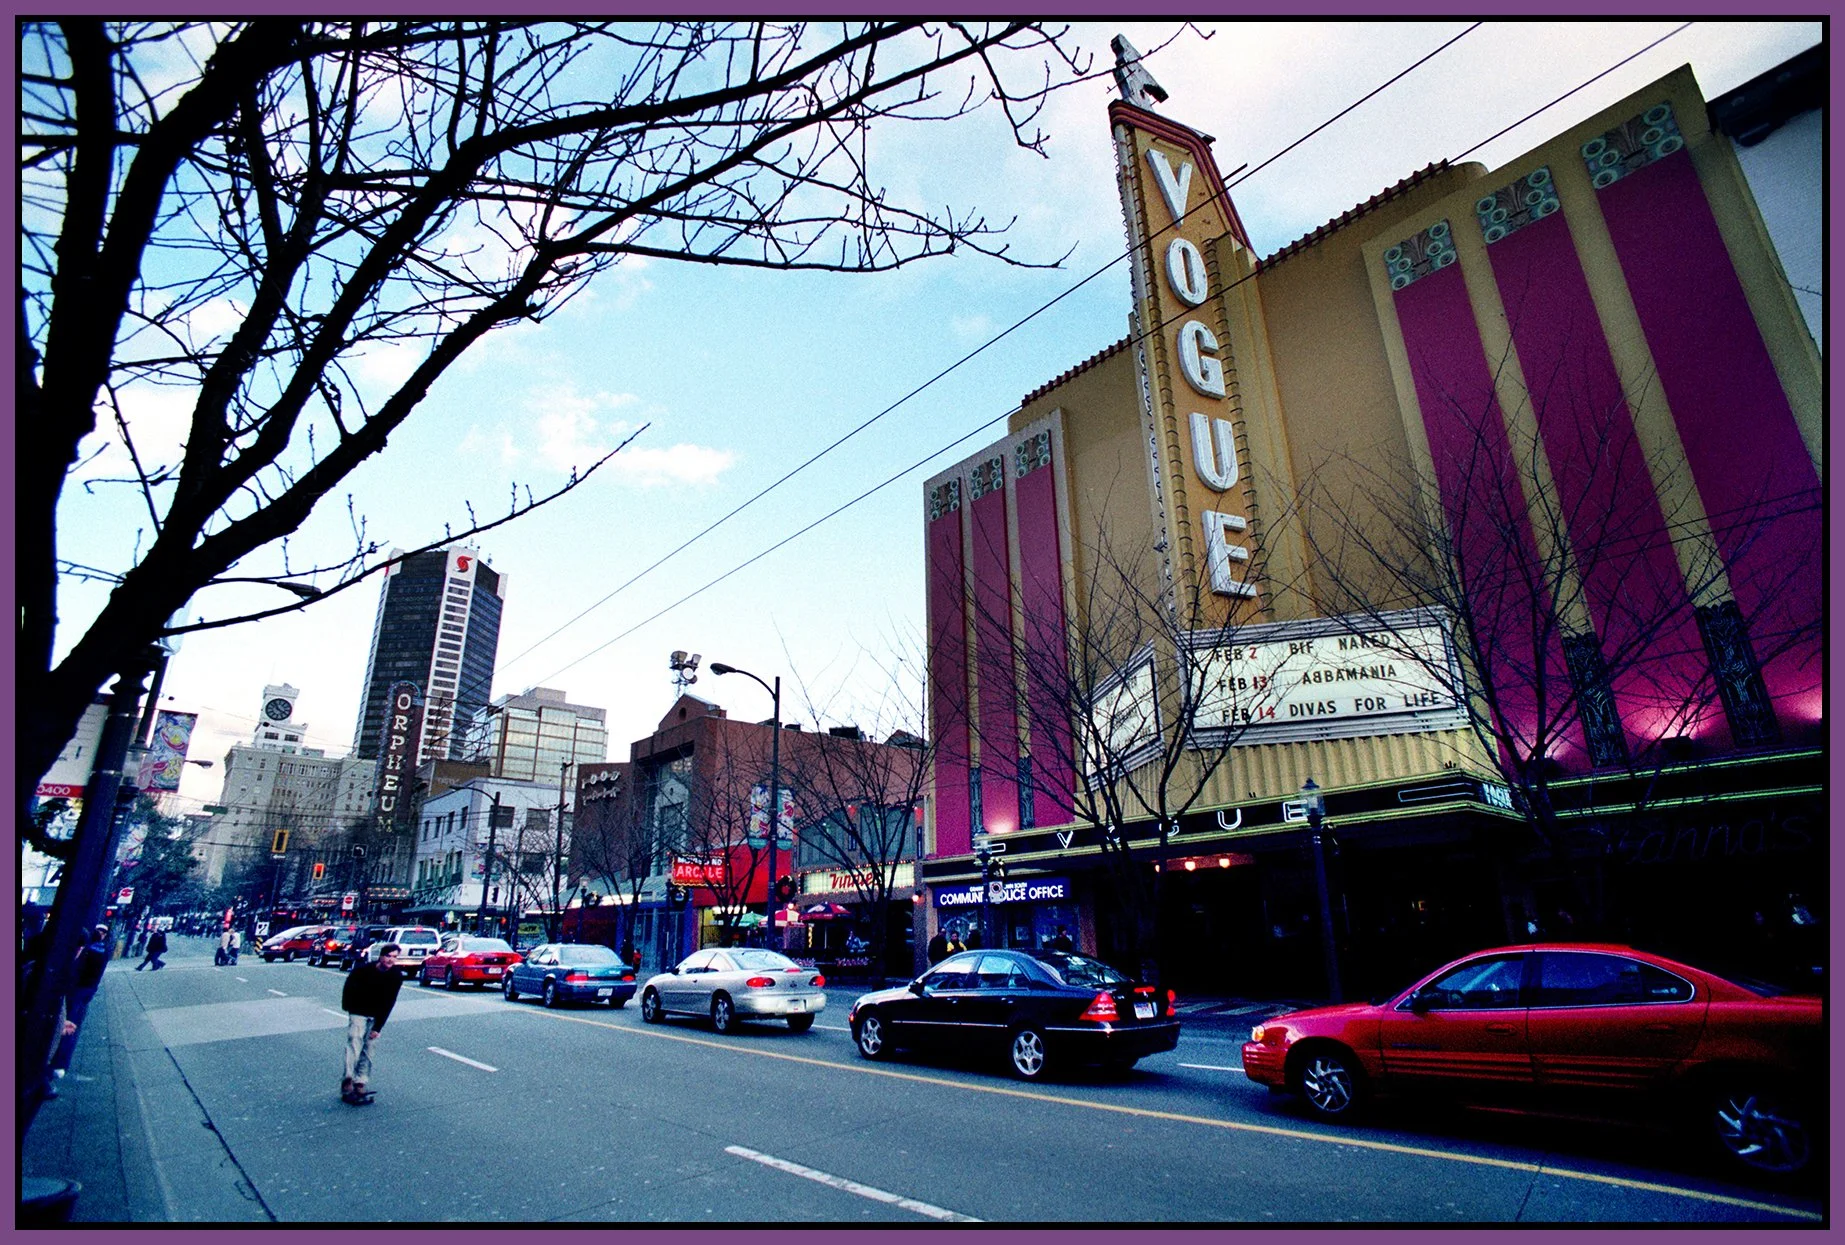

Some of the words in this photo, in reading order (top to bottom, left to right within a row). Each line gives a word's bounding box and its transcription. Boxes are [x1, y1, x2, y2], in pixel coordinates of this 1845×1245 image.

[1145, 147, 1257, 599] VOGUE
[1215, 648, 1242, 662] FEB
[1249, 646, 1257, 660] 2
[1289, 641, 1314, 655] BIF
[1338, 634, 1390, 650] NAKED
[1219, 677, 1247, 693] FEB
[1253, 676, 1268, 690] 13
[1302, 664, 1397, 685] ABBAMANIA
[1221, 707, 1250, 722] FEB
[1259, 705, 1275, 719] 14
[1290, 700, 1337, 717] DIVAS
[1355, 697, 1386, 712] FOR
[1403, 692, 1441, 708] LIFE
[377, 693, 412, 833] ORPHEUM
[1028, 884, 1064, 900] OFFICE
